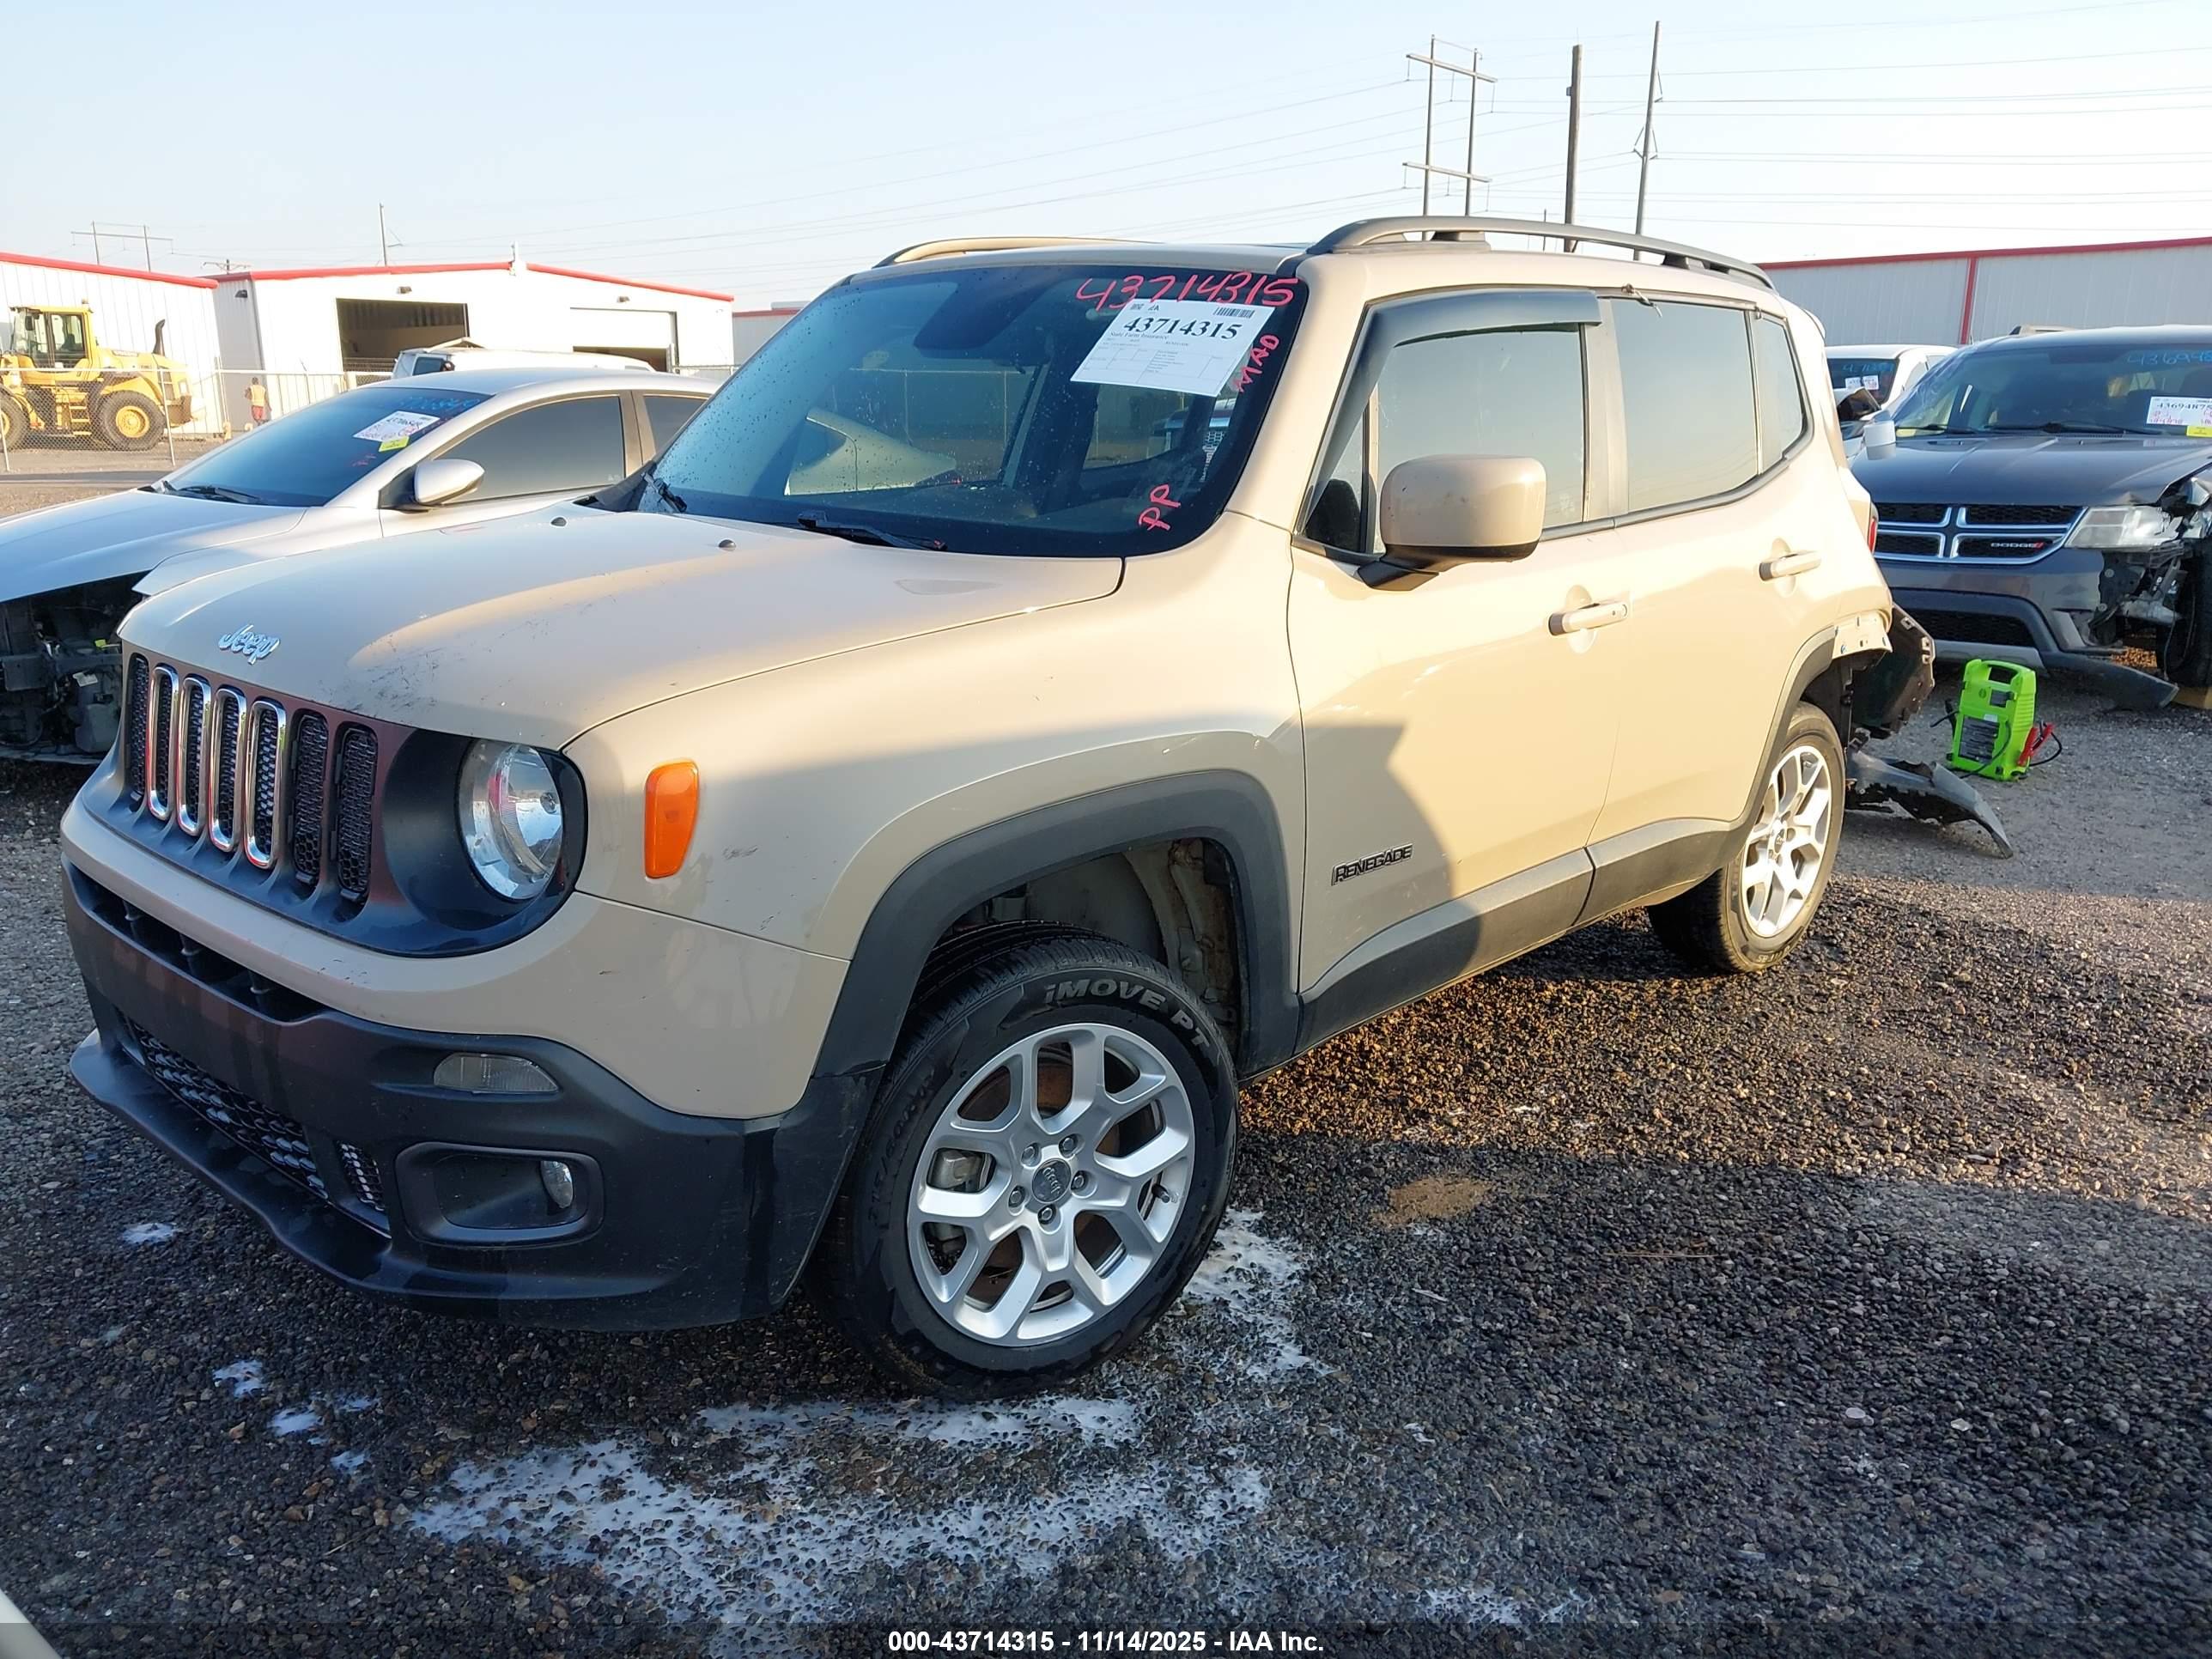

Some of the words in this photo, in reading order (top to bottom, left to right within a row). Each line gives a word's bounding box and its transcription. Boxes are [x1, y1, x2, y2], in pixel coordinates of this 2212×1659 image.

[1124, 317, 1243, 339] 43714315
[218, 624, 280, 665] Jeep
[1331, 843, 1413, 886] RENEGADE
